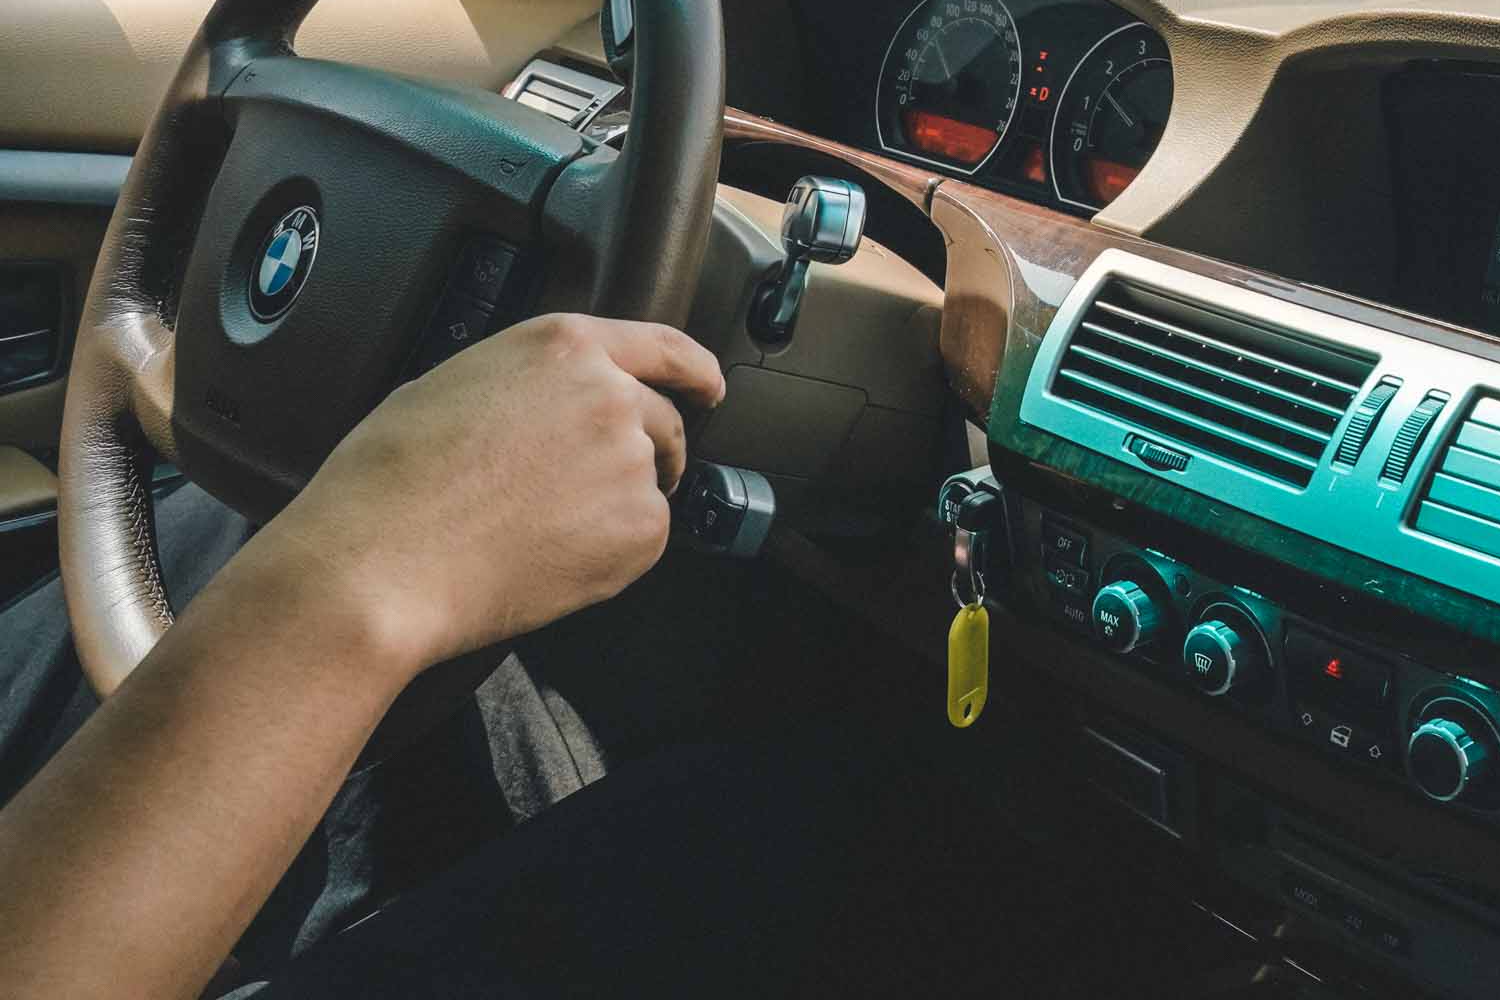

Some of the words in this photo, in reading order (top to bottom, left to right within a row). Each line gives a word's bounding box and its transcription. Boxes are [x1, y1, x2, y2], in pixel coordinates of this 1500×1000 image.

[930, 16, 943, 28] 80
[917, 30, 929, 41] 60
[1138, 40, 1147, 55] 3
[905, 49, 918, 61] 40
[1105, 60, 1114, 75] 2
[898, 69, 911, 81] 20
[899, 94, 907, 105] 0
[1040, 87, 1049, 101] D
[1083, 95, 1091, 110] 1
[1073, 138, 1082, 152] 0
[272, 213, 315, 251] BMW
[1056, 536, 1073, 550] OFF
[1100, 610, 1120, 628] MAX
